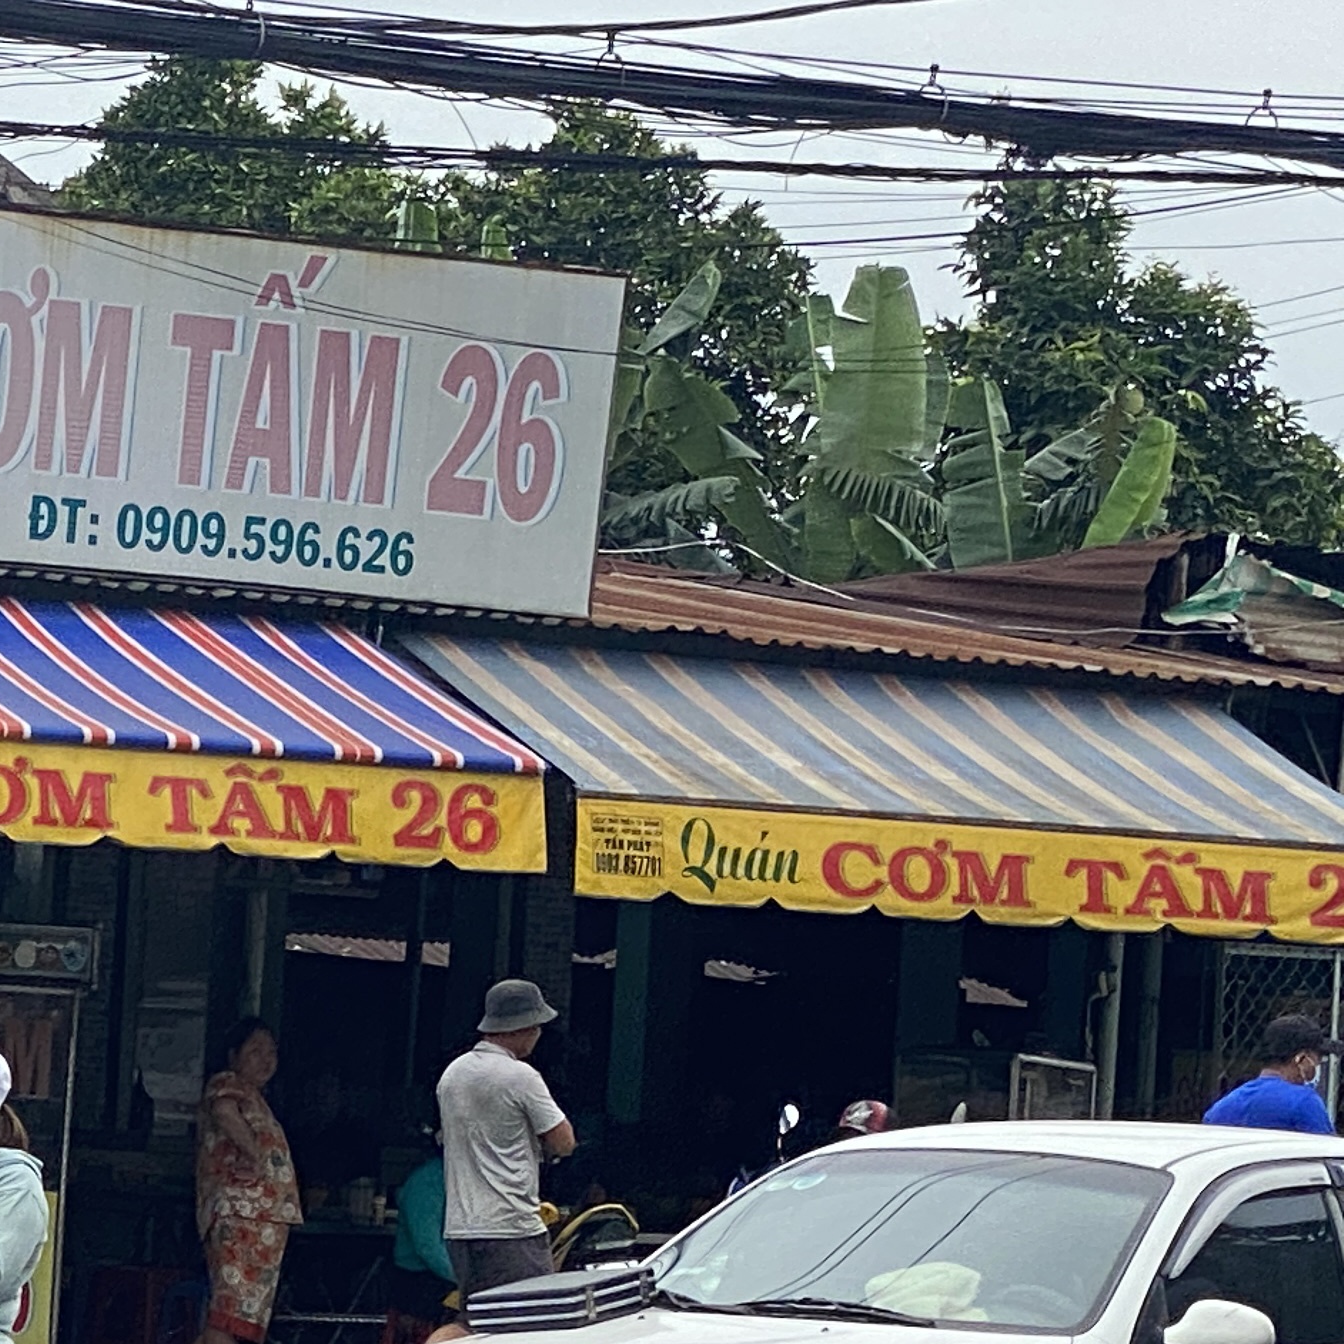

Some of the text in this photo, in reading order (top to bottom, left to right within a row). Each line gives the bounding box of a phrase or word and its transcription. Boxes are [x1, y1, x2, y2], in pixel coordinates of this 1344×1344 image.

[170, 255, 404, 505] TẤM
[425, 343, 562, 523] 26
[28, 494, 415, 577] ĐT: 0909.596.626
[146, 761, 358, 844] TẤM
[391, 779, 500, 855] 26
[680, 816, 802, 895] Quán
[821, 838, 1033, 908] CƠM
[1064, 846, 1278, 926] TẤM
